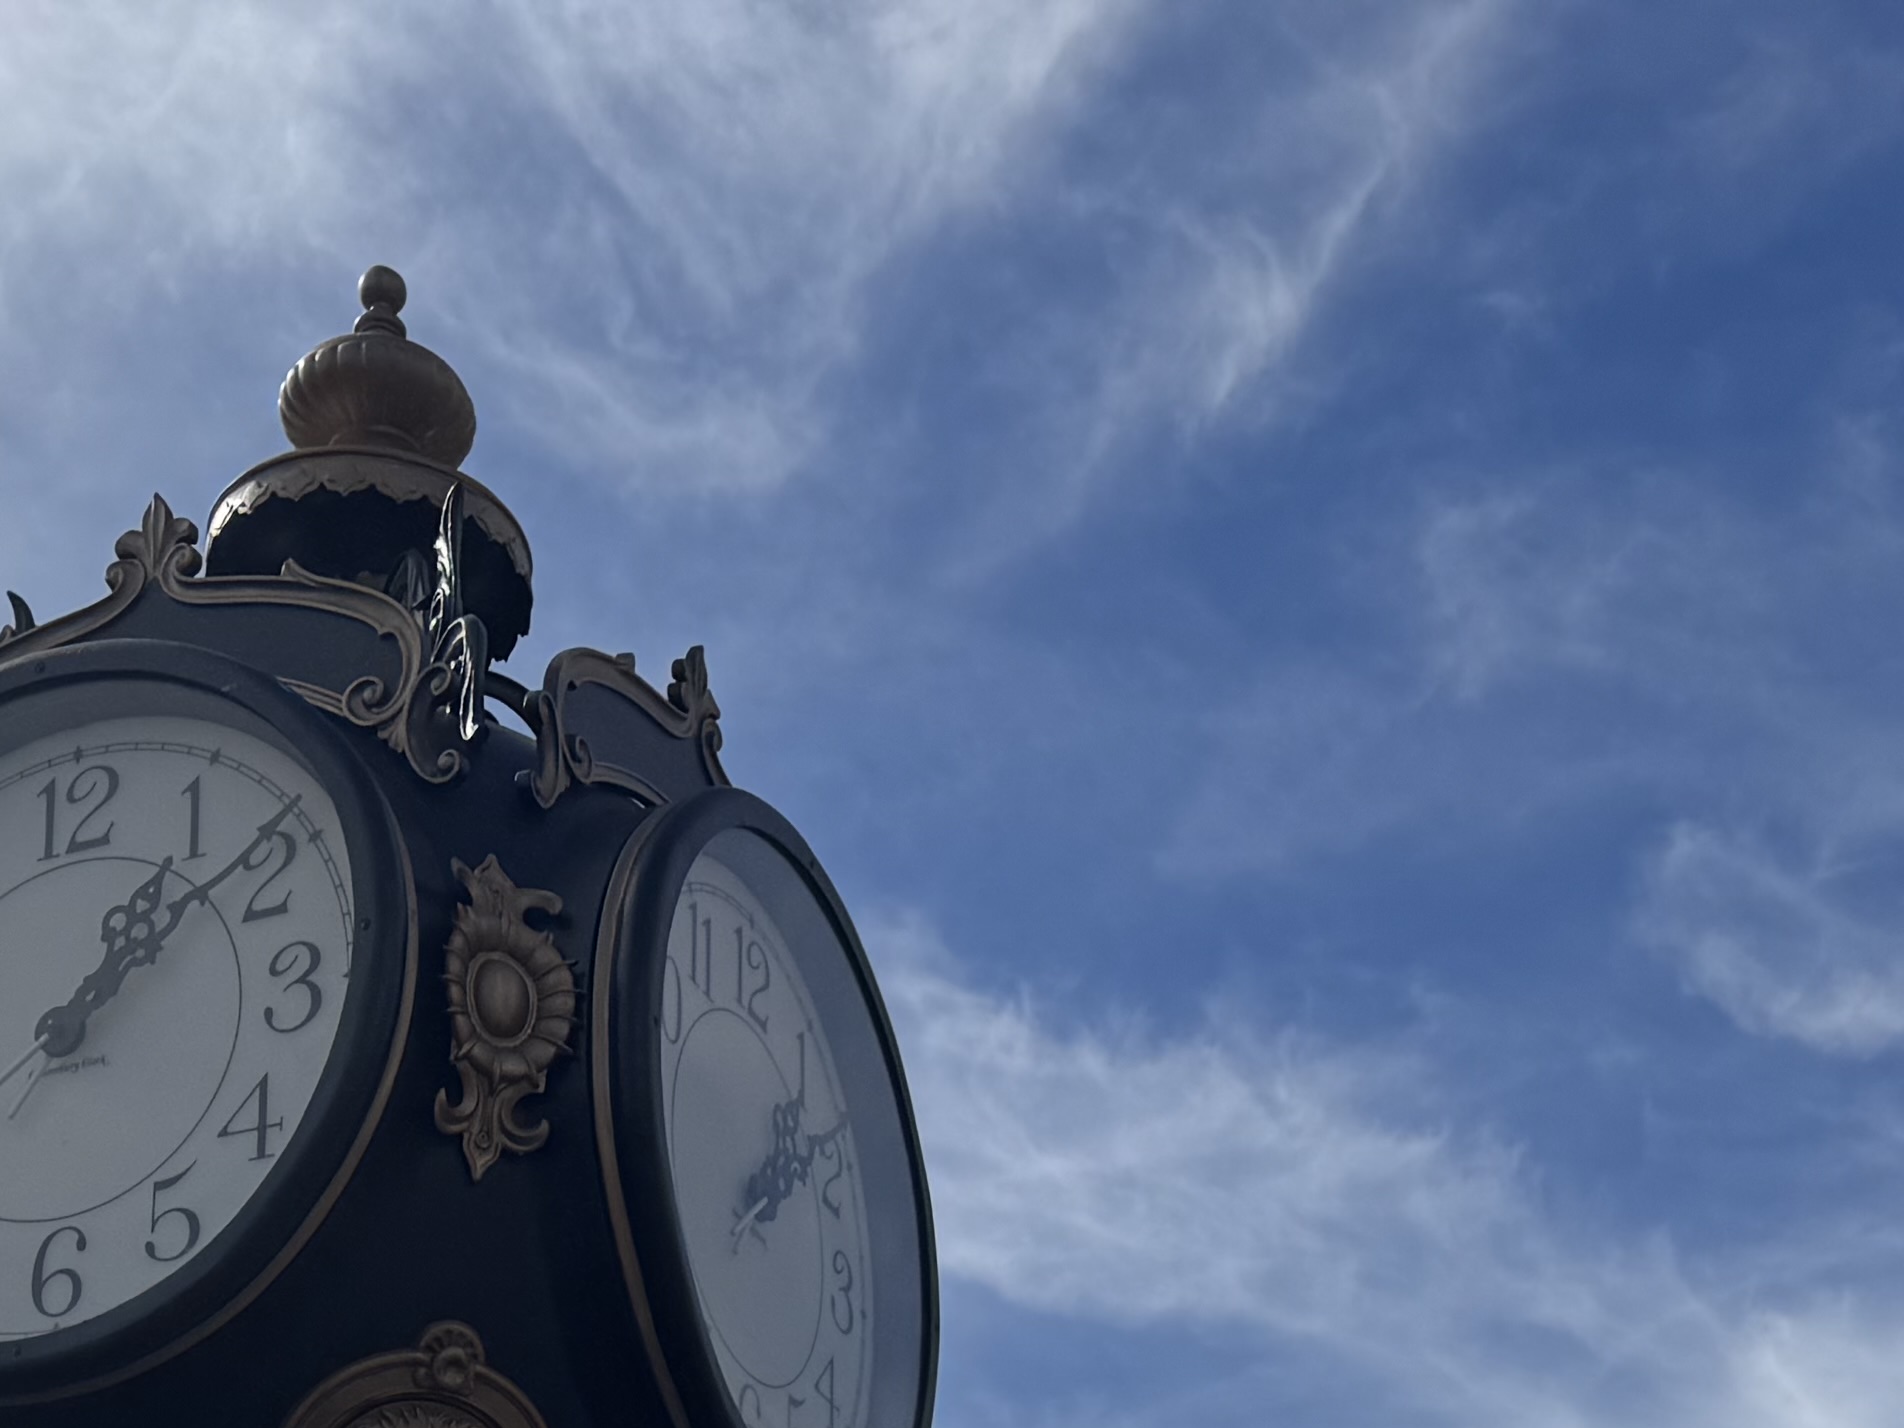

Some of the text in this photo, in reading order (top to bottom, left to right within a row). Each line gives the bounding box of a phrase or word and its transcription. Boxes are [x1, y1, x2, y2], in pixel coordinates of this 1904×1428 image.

[36, 763, 119, 862] 12
[180, 774, 212, 861] 1
[241, 829, 298, 925] 2
[263, 940, 324, 1034] 3
[662, 954, 683, 1044] 0
[687, 901, 715, 1004] 11
[733, 925, 774, 1035] 12
[217, 1072, 285, 1162] 4
[143, 1160, 203, 1263] 5
[30, 1225, 89, 1318] 6
[830, 1248, 857, 1336] 3
